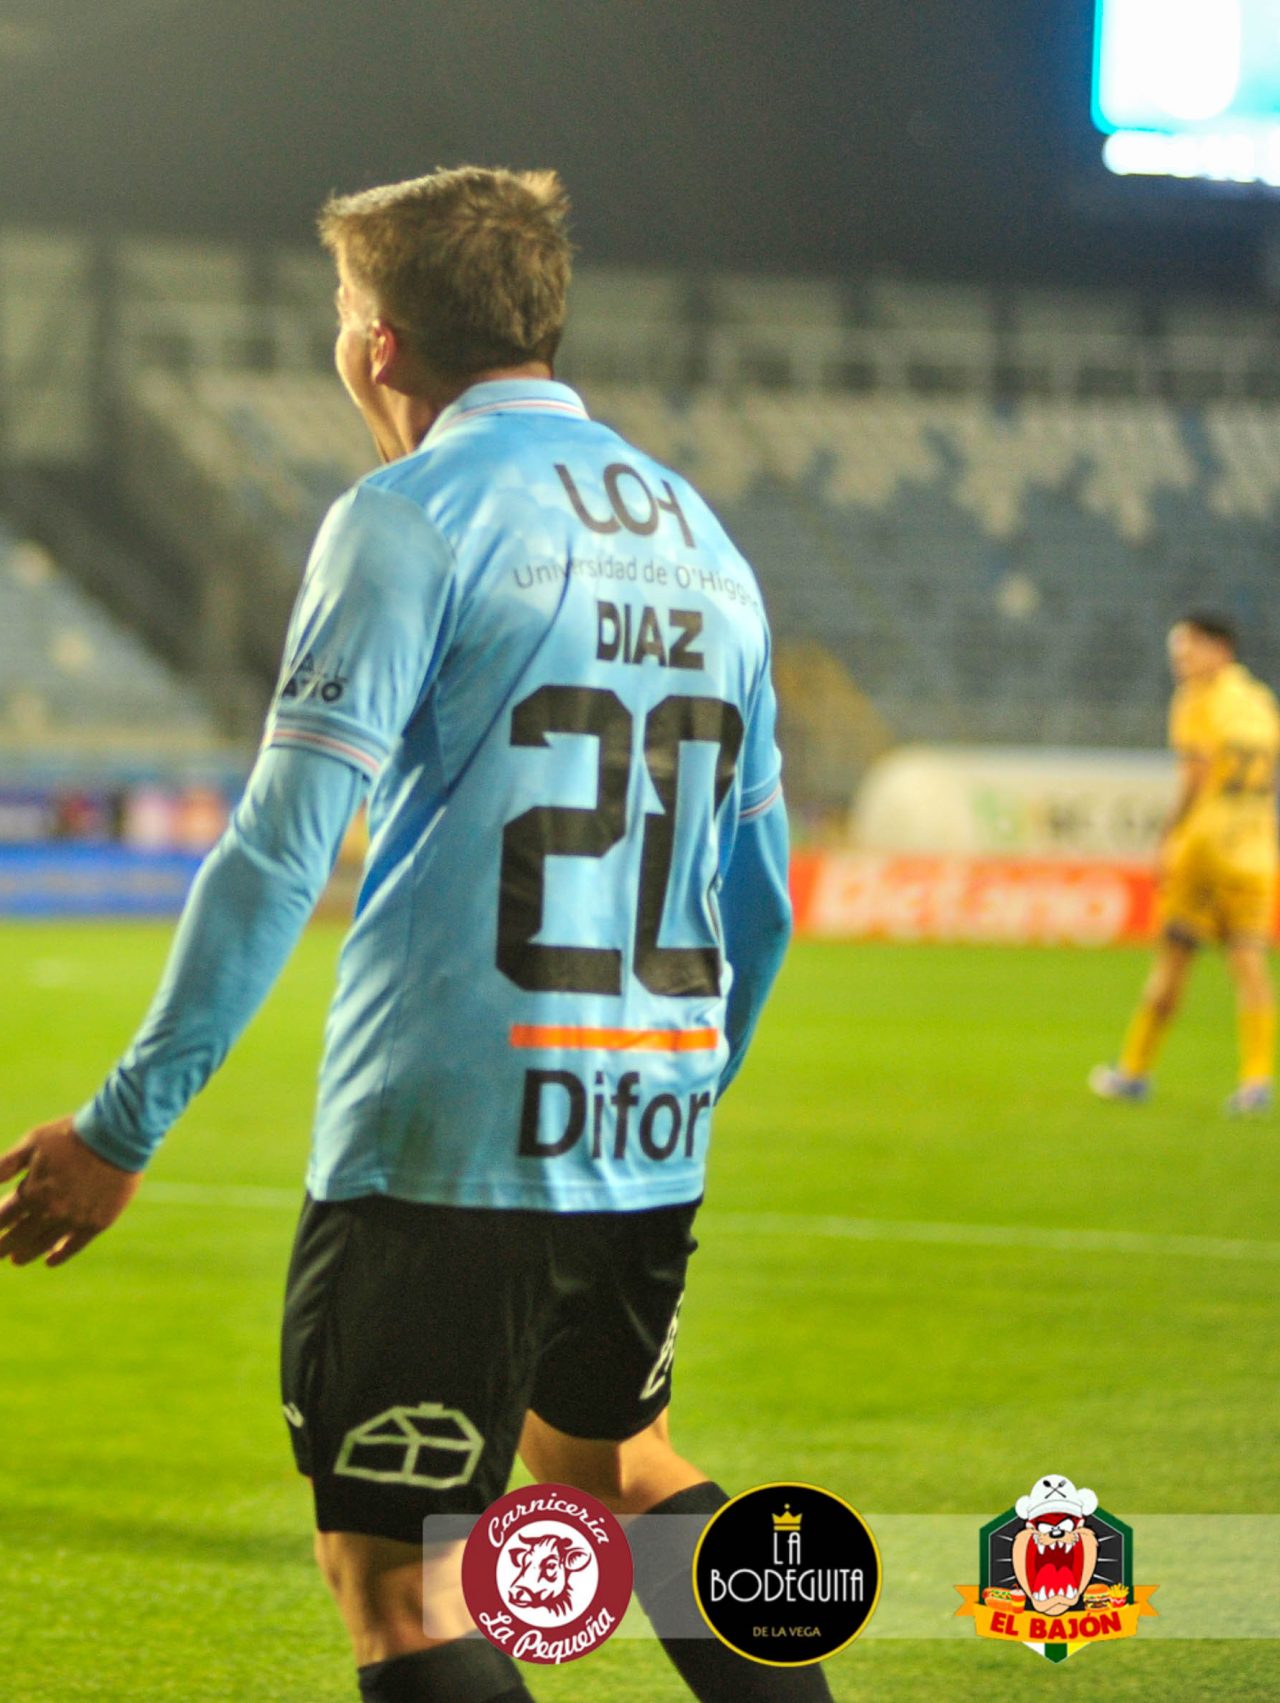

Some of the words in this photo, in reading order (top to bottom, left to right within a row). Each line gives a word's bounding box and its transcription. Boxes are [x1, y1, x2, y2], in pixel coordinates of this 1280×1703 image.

[513, 554, 637, 590] Universidad
[643, 561, 668, 586] de
[595, 599, 705, 671] DIAZ
[495, 684, 745, 998] 20
[517, 1067, 711, 1162] Difor
